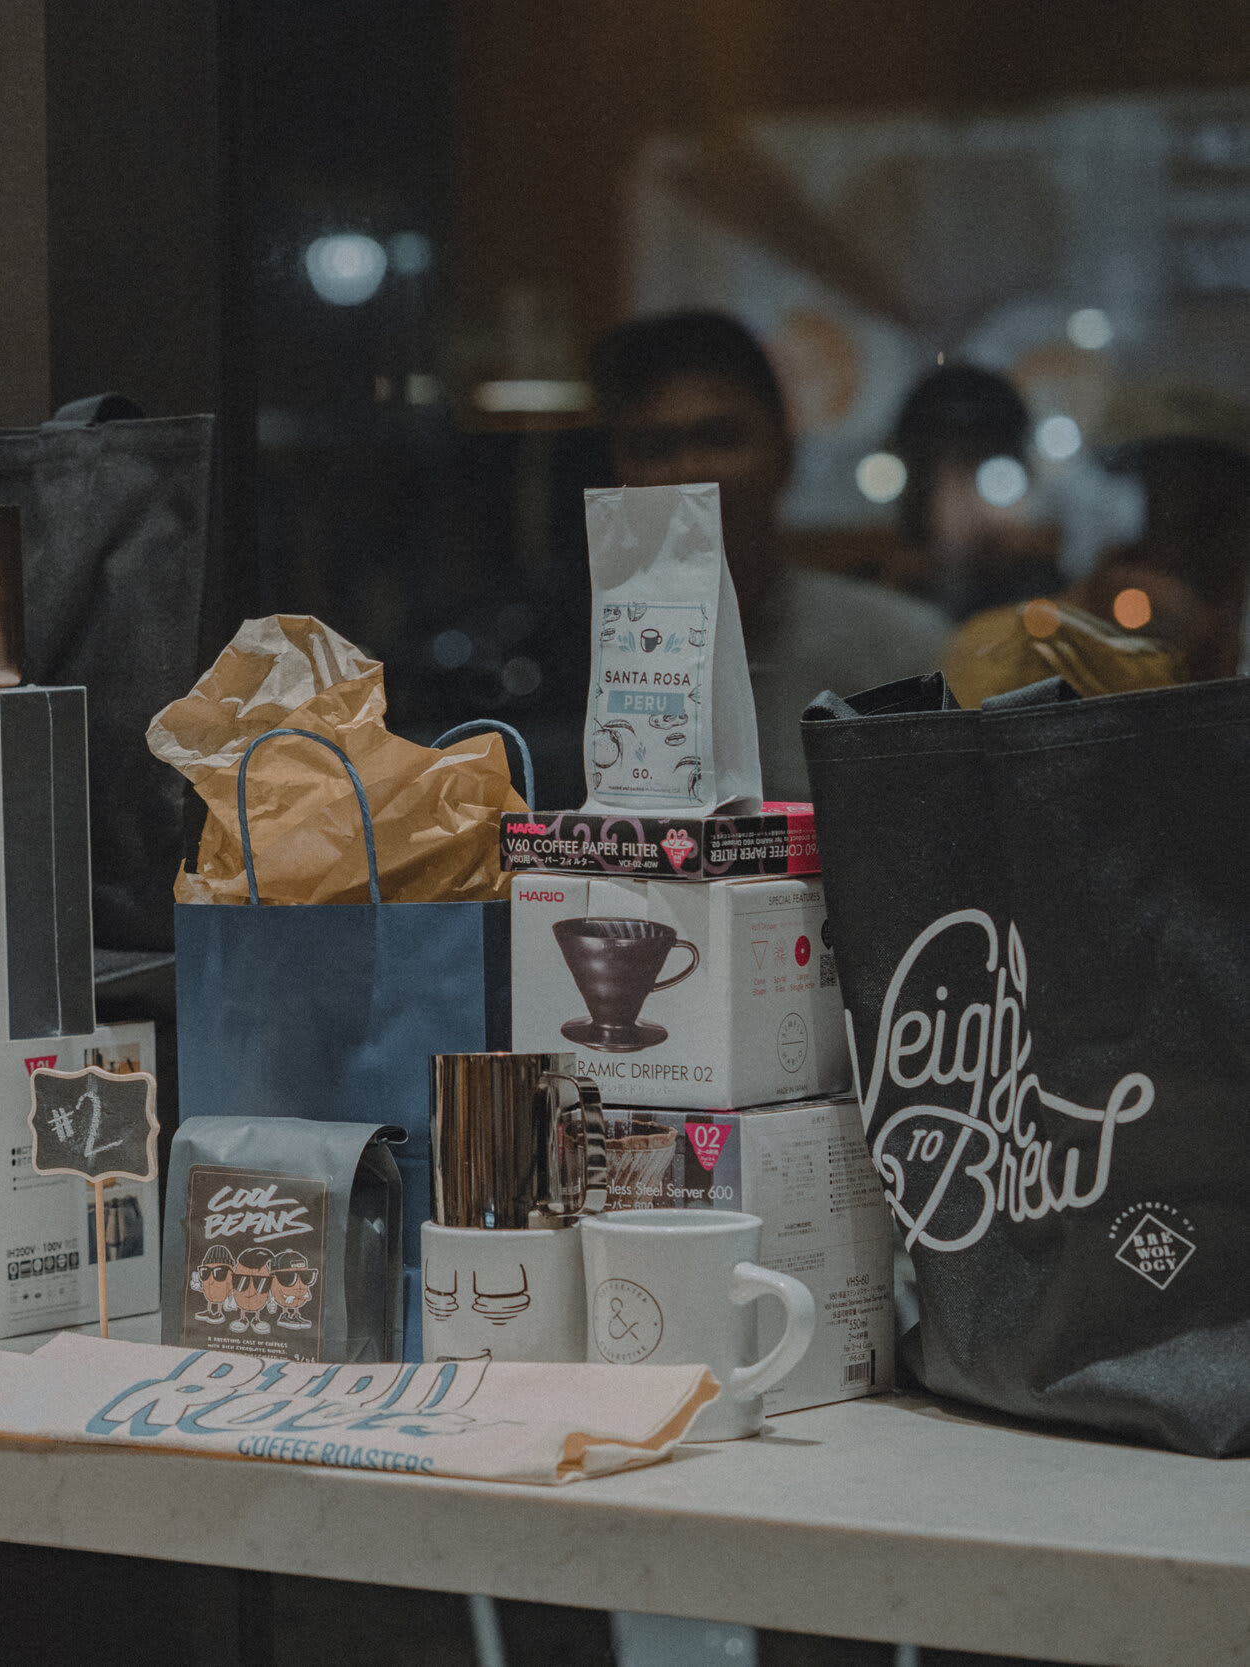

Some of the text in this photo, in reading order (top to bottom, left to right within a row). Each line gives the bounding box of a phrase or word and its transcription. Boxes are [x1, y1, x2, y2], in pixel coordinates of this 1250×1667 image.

[605, 670, 691, 686] SANTA ROSA
[624, 695, 667, 711] PERU
[632, 768, 652, 780] GO.
[506, 823, 546, 835] HARIO
[666, 829, 688, 846] 02
[506, 839, 658, 858] V60 COFFEE PAPER FILTER
[710, 848, 737, 862] FILTER
[740, 847, 766, 860] PAPER
[769, 844, 802, 858] COFFEE
[519, 891, 565, 903] HARIO
[769, 892, 820, 905] SPECIAL FEATURES
[578, 1061, 712, 1083] RAMIC DRIPPER 02
[48, 1091, 124, 1158] #2
[695, 1126, 720, 1147] 02
[873, 1073, 1154, 1256] Brew
[607, 1179, 733, 1200] nless Steel Server 600
[208, 1184, 299, 1212] COOL
[204, 1206, 314, 1243] BEANS
[1134, 1231, 1173, 1247] BRE
[1135, 1245, 1176, 1260] WOL
[1139, 1258, 1177, 1273] OGY
[238, 1436, 434, 1473] COFFEE ROASTERS
